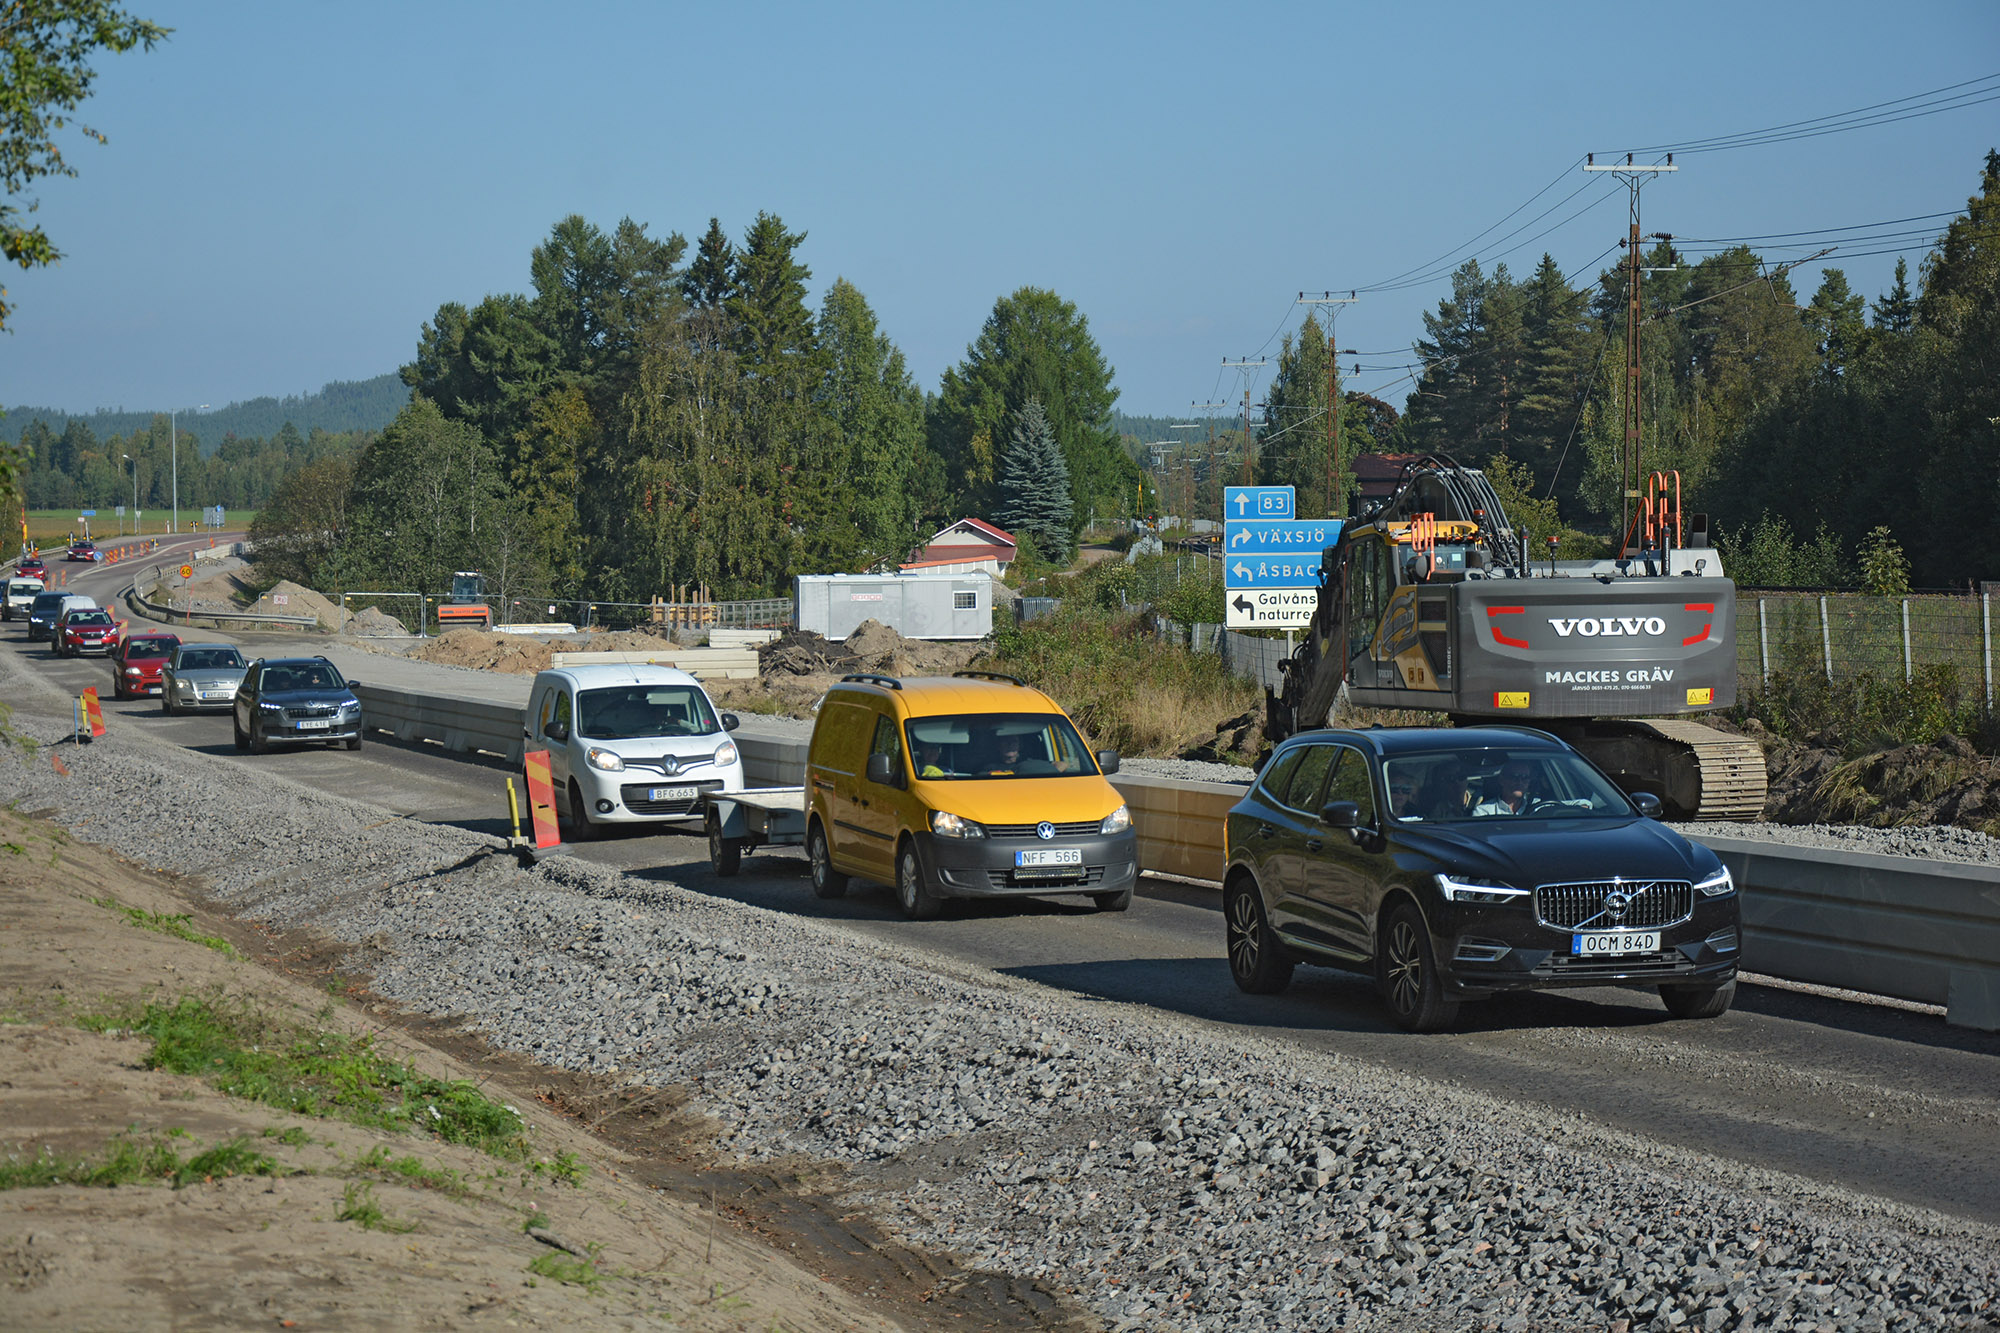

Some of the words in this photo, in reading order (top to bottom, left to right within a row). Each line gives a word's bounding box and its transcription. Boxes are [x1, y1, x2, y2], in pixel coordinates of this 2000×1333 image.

[1263, 497, 1285, 510] 83
[1257, 528, 1325, 543] VÄXSJÖ
[1258, 562, 1322, 577] ÅSBAC
[1258, 593, 1316, 605] Galvåns
[1547, 617, 1666, 637] VOLVO
[1545, 670, 1620, 683] MACKES
[1626, 666, 1674, 682] GRÄV
[656, 790, 674, 798] BFG
[676, 788, 694, 798] 663
[1023, 852, 1046, 864] NFF
[1055, 851, 1079, 862] 566
[1586, 936, 1618, 951] OCM
[1623, 934, 1654, 950] 84D
